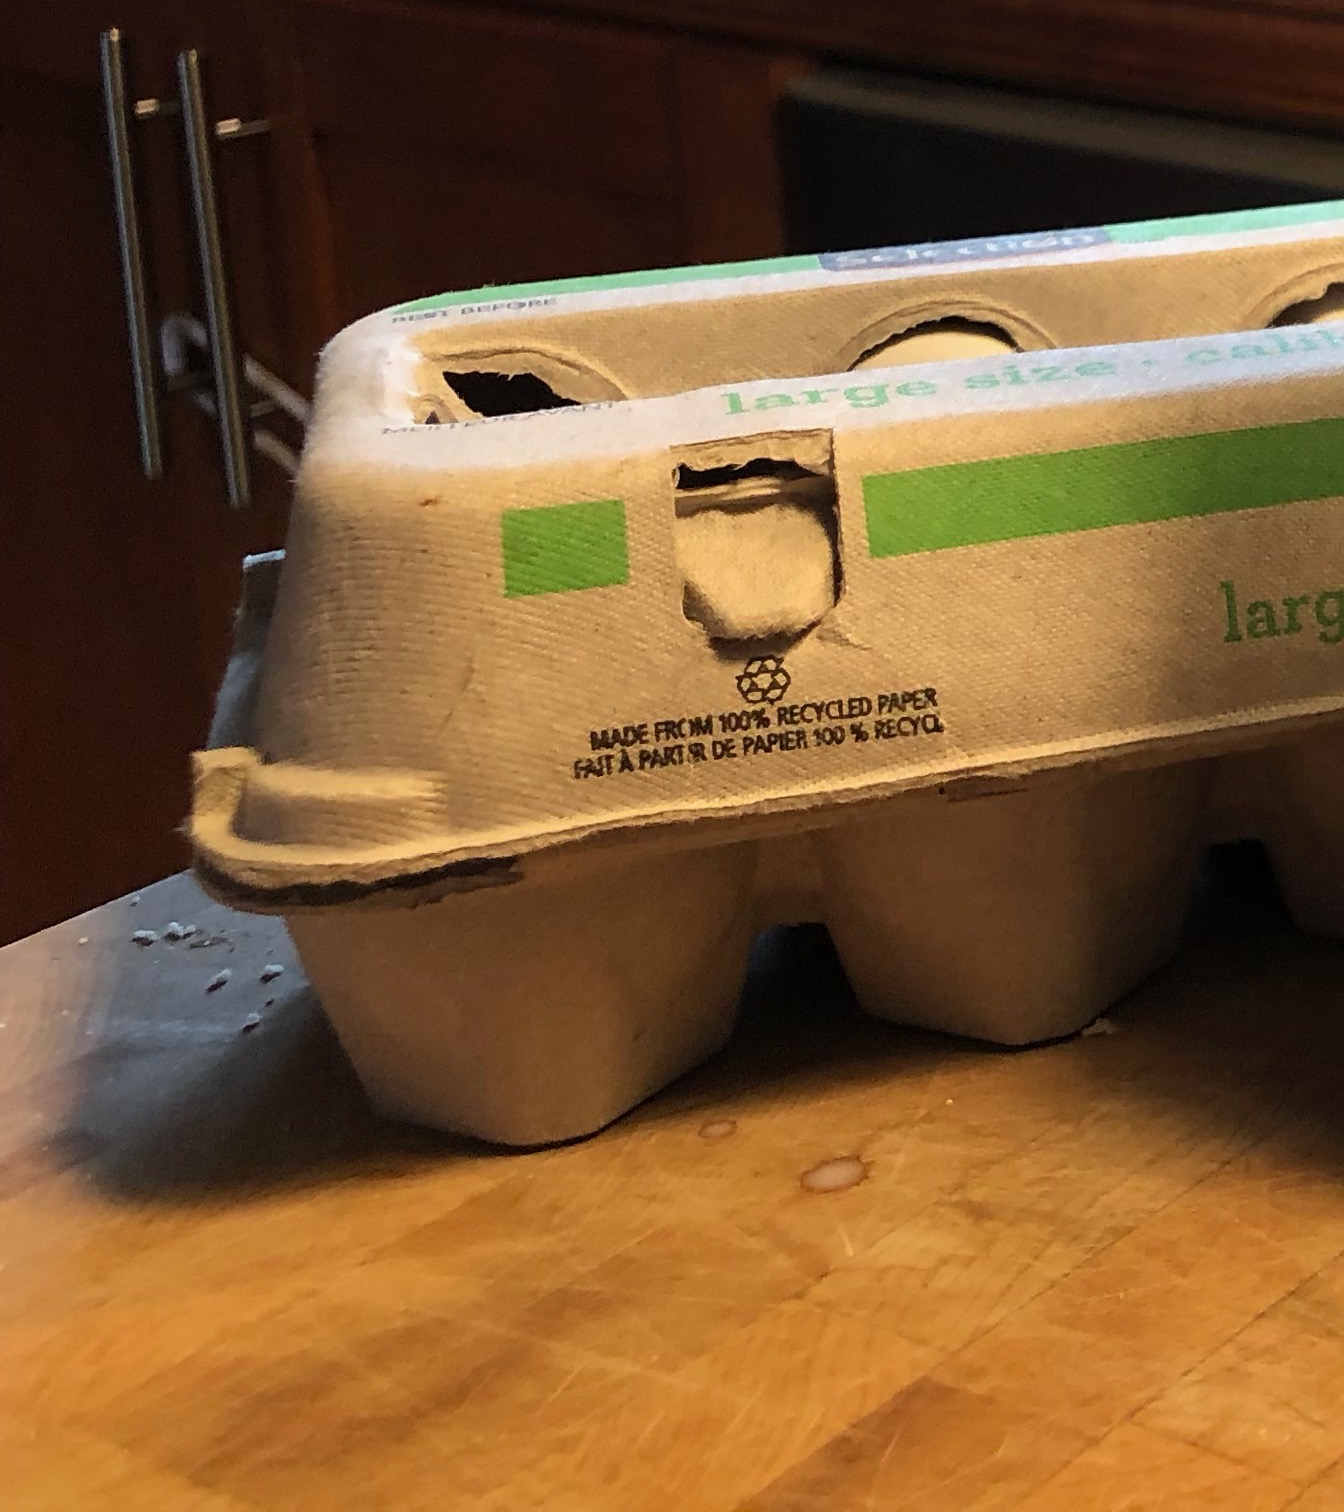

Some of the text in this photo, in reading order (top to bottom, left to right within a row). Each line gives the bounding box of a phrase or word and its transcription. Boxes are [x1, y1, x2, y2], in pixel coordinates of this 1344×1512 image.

[720, 379, 937, 416] large
[964, 361, 1116, 391] size
[590, 687, 938, 750] MADE FROM 100% RECYCLED PAPER
[573, 754, 615, 780] FAIT
[618, 748, 634, 774] À
[639, 742, 708, 770] PARTIR
[711, 738, 737, 761] DE
[743, 728, 809, 756] PAPIER
